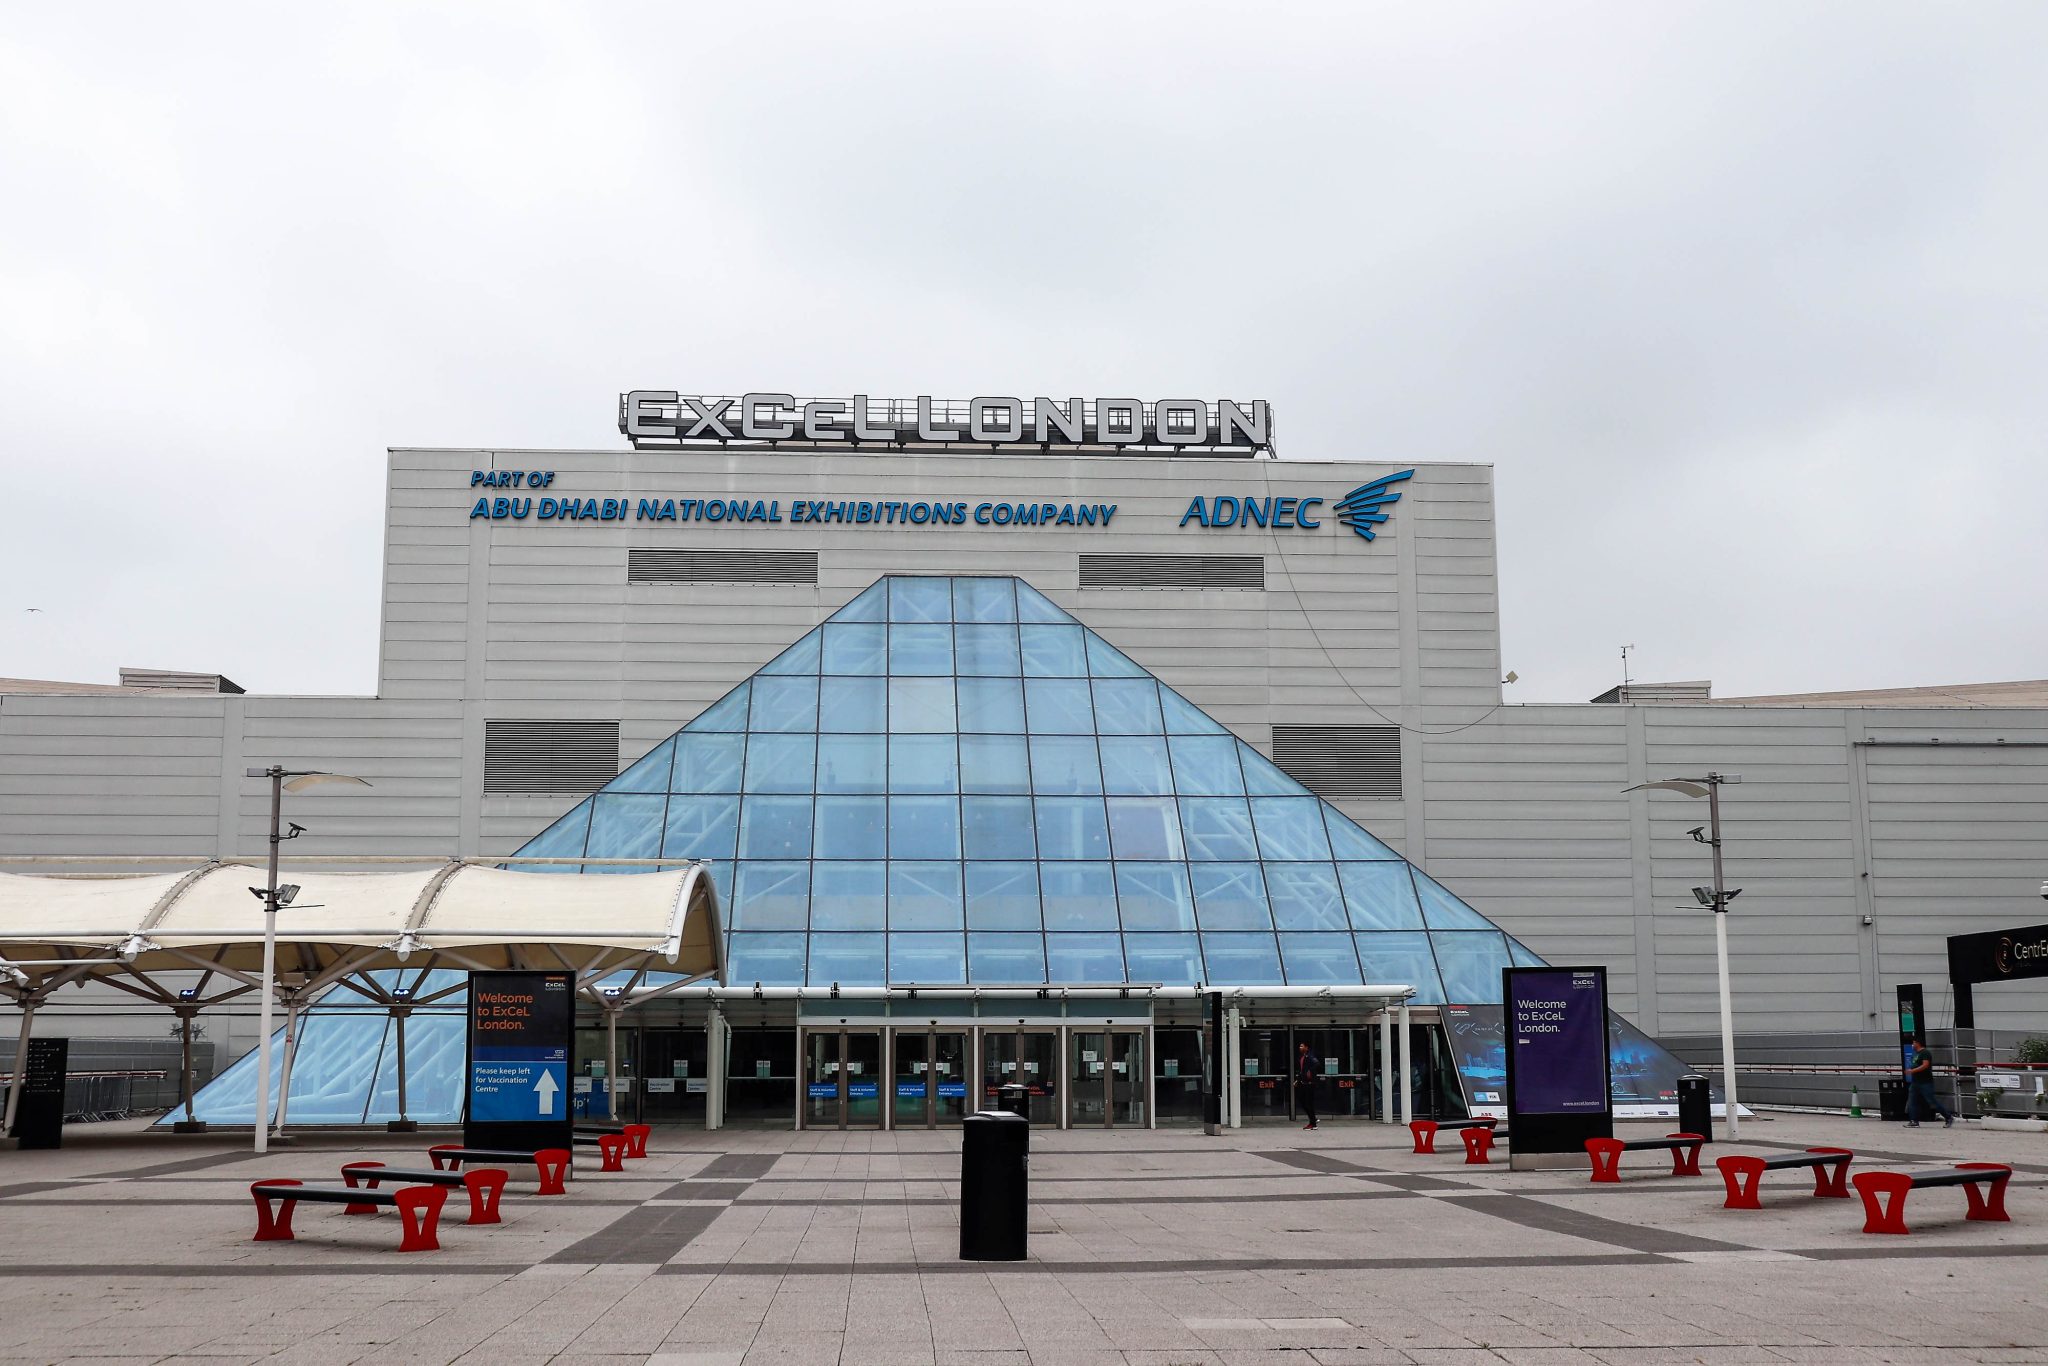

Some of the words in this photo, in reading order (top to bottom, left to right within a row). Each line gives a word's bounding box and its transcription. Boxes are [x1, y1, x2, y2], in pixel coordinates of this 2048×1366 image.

[918, 394, 1267, 445] LONDON
[470, 470, 524, 488] PART
[527, 471, 555, 488] OF
[469, 497, 532, 520] ABU
[537, 498, 629, 521] DHABI
[636, 499, 783, 523] NATIONAL
[790, 500, 967, 525] EXHIBITIONS
[974, 502, 1118, 527] COMPANY
[1179, 495, 1324, 530] ADNEC
[2014, 939, 2048, 960] CentrE
[478, 993, 533, 1003] Welcome
[1518, 999, 1567, 1008] Welcome
[477, 1007, 489, 1016] to
[493, 1006, 530, 1016] ExCeL
[1518, 1012, 1529, 1020] to
[1532, 1011, 1565, 1020] ExCeL
[477, 1020, 525, 1029] London.
[1519, 1023, 1560, 1032] London.
